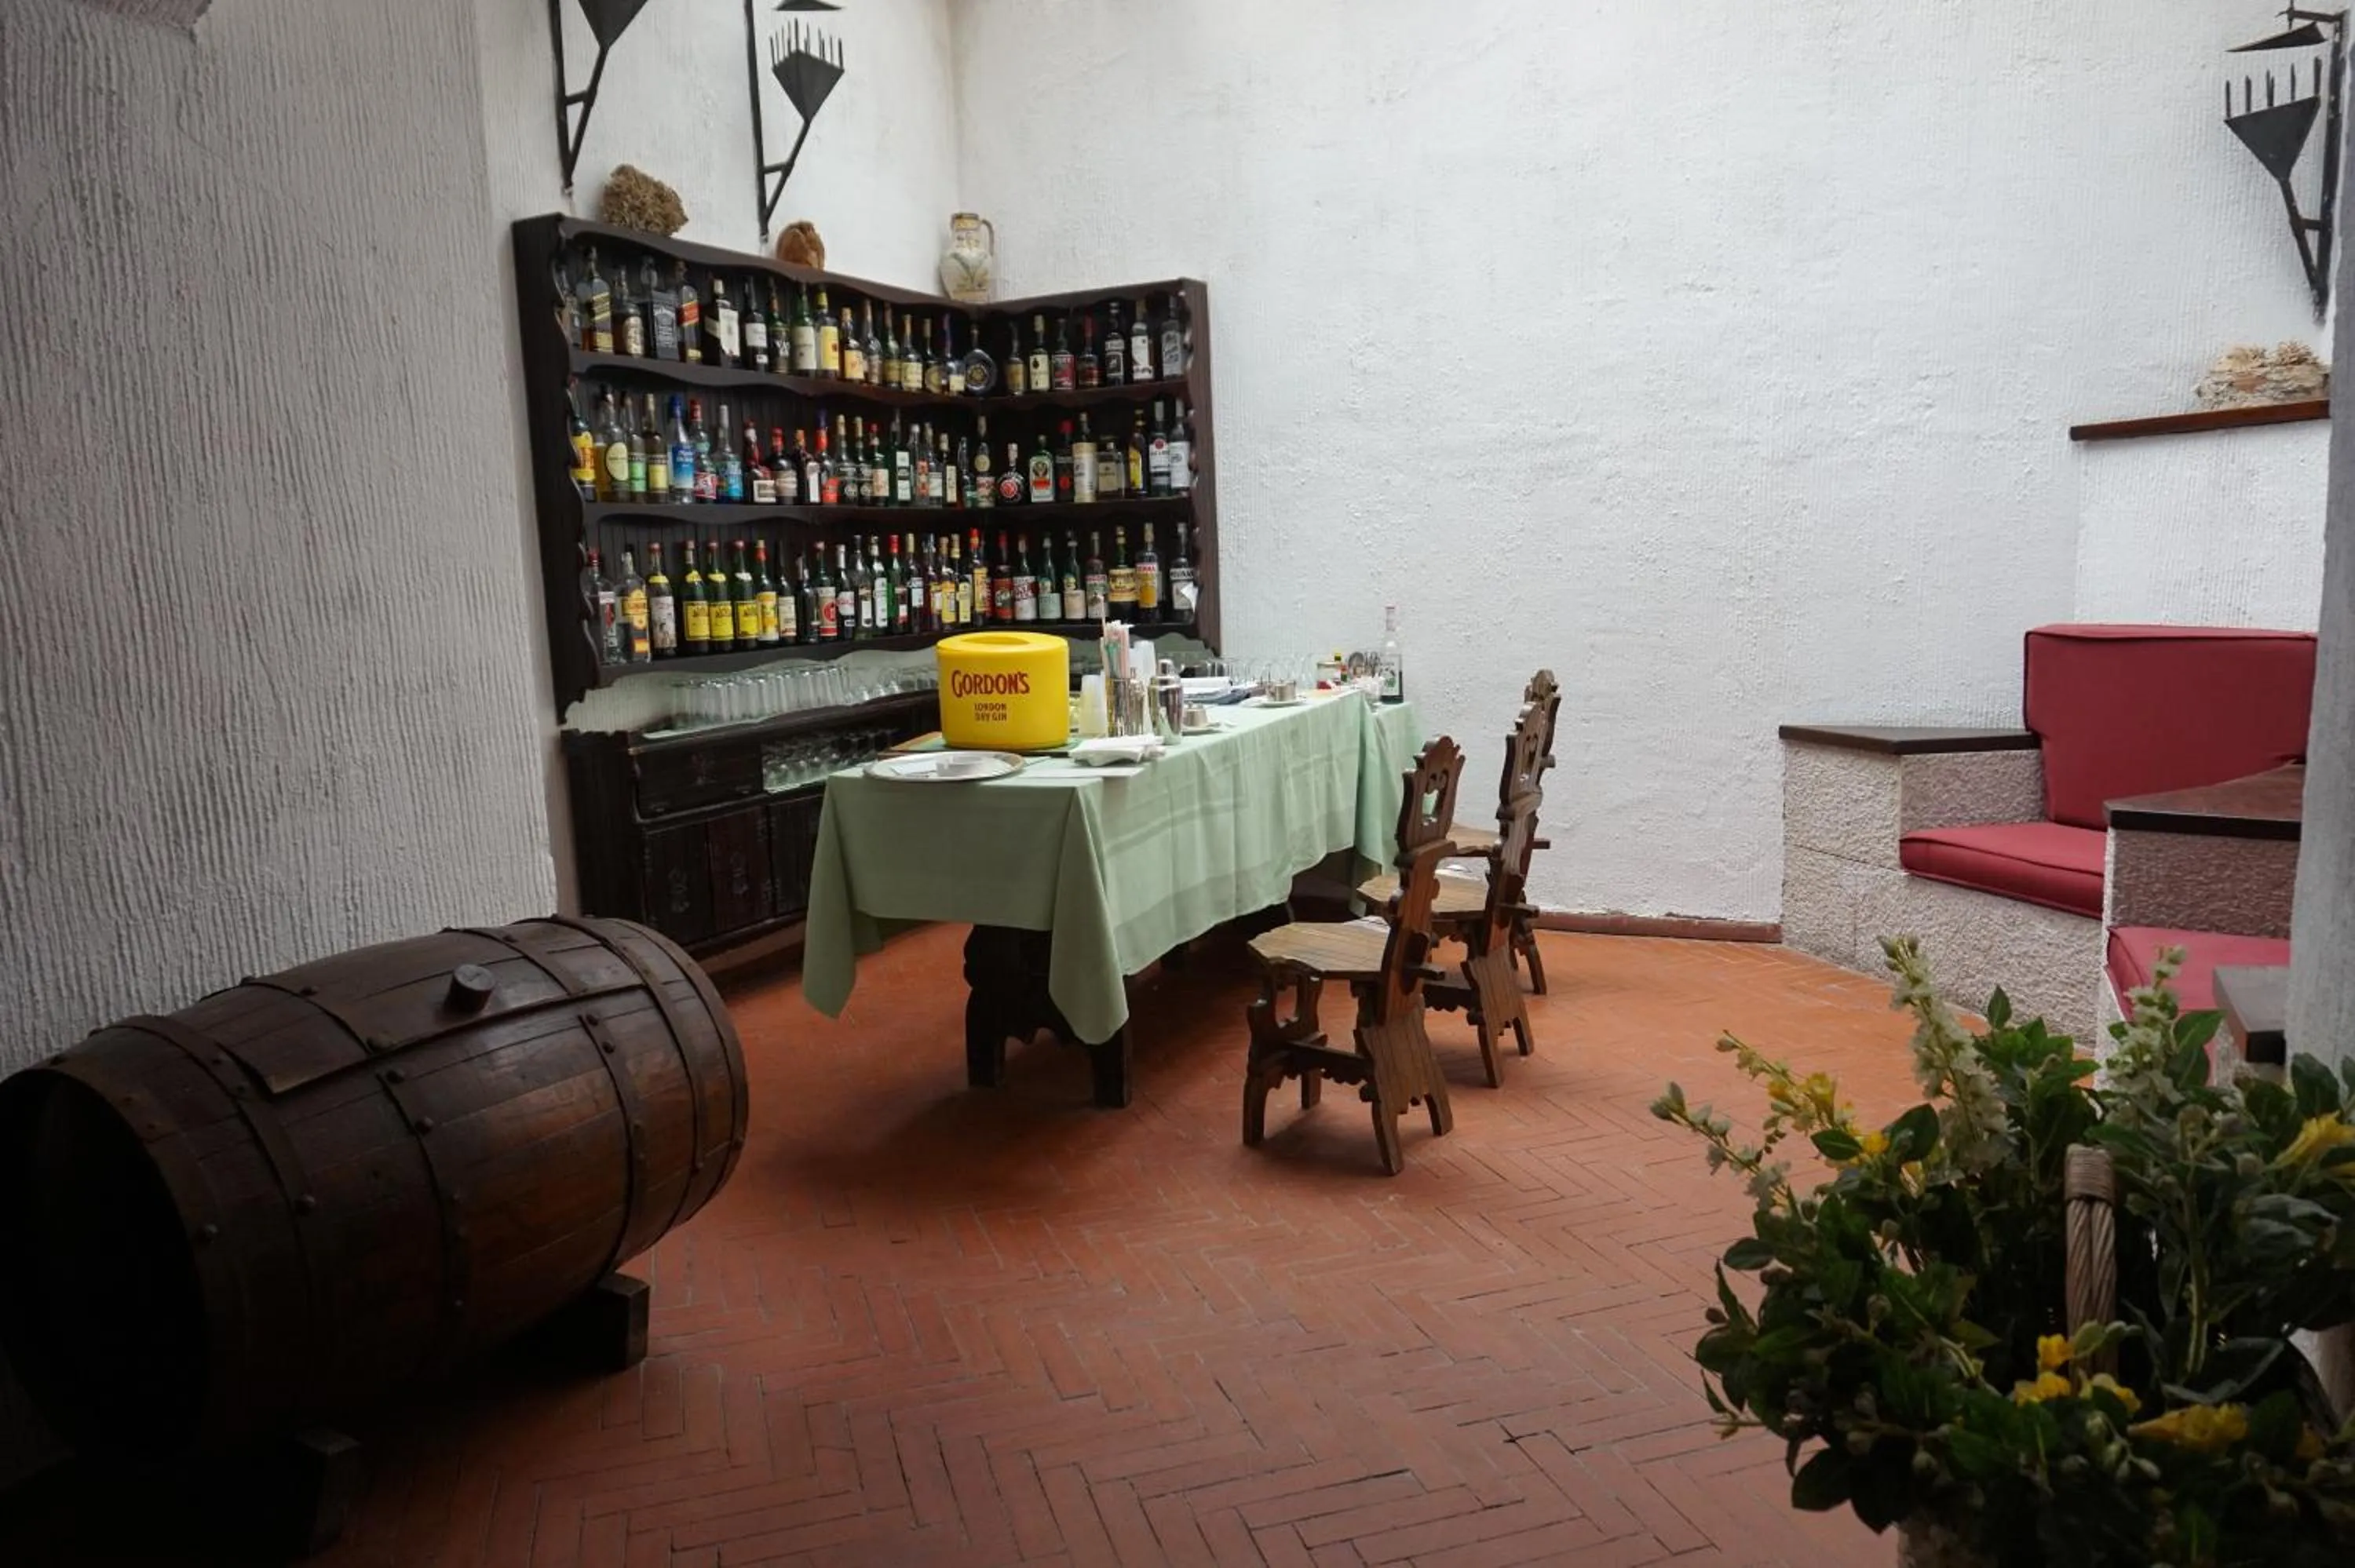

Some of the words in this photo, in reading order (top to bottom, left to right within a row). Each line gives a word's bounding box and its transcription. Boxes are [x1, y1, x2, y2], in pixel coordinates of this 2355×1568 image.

[951, 669, 1030, 698] GORDON'S
[974, 702, 1007, 711] LONDON
[974, 712, 990, 722] DRY
[992, 712, 1008, 722] GIN
